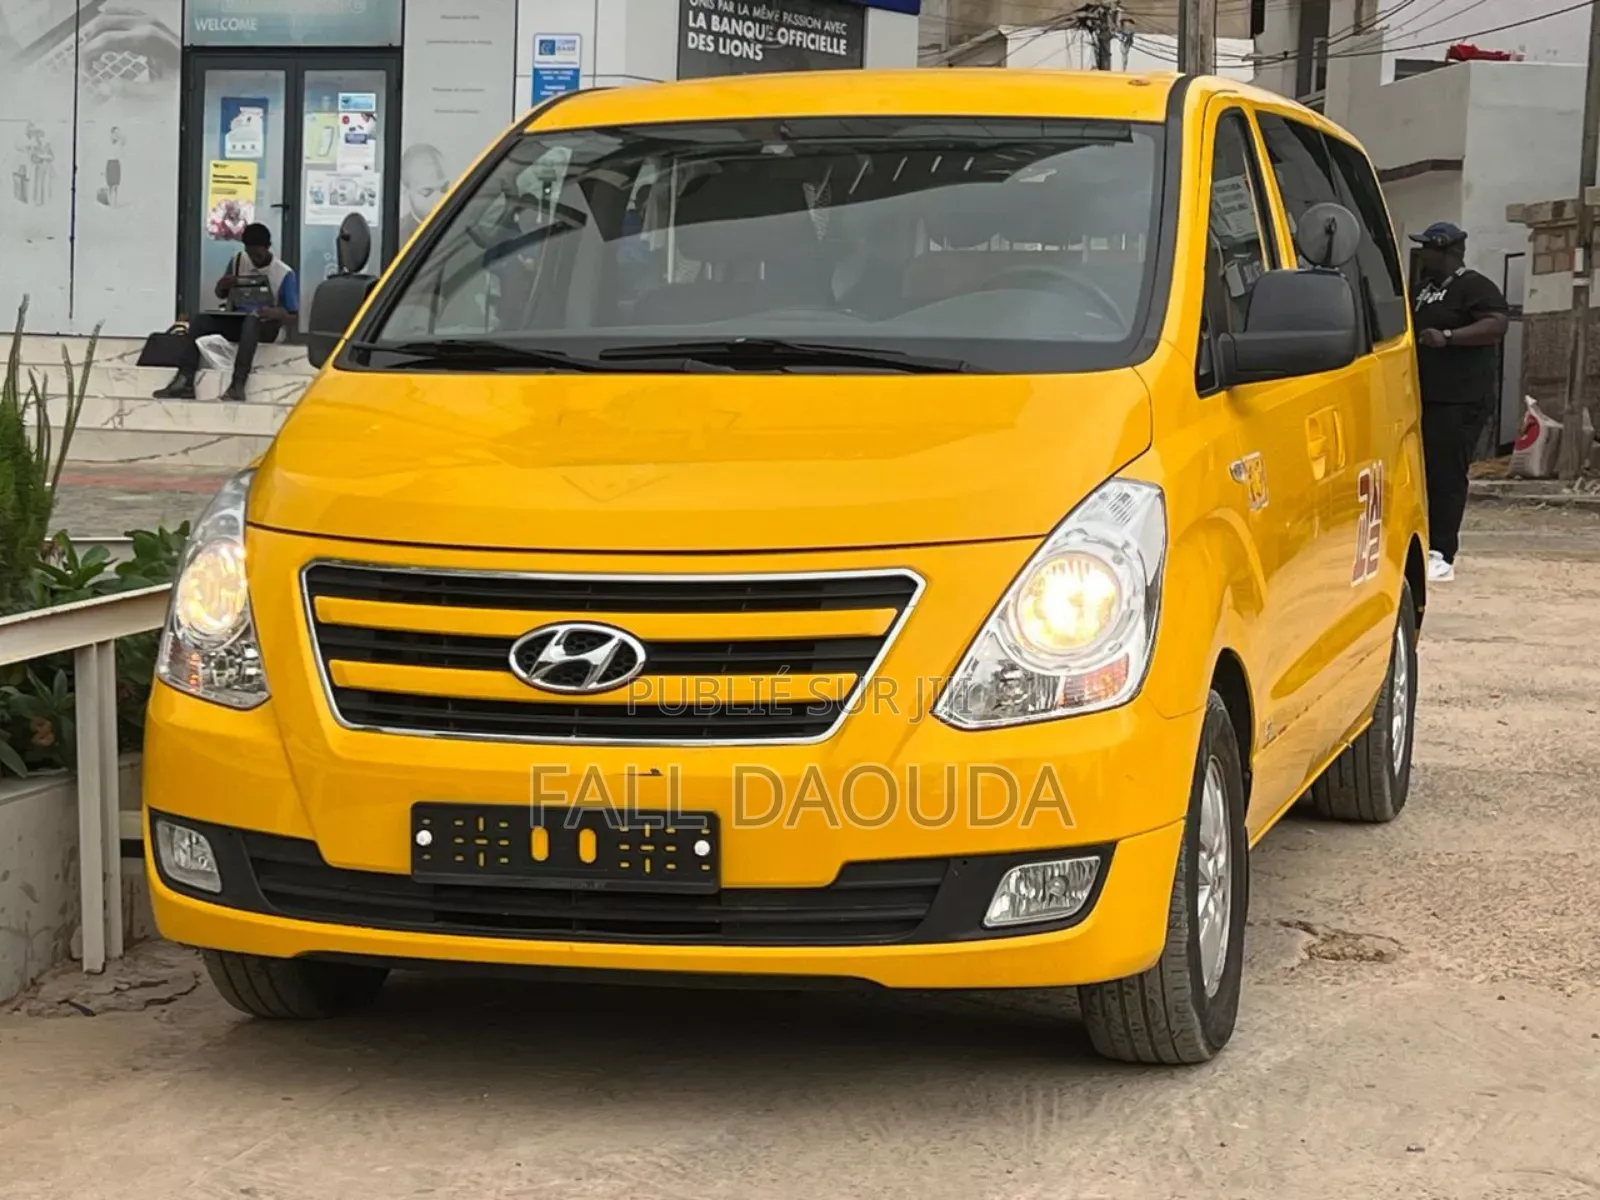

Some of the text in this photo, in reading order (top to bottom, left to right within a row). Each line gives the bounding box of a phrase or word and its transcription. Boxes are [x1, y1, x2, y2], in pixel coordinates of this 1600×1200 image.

[194, 17, 258, 31] WELCOME
[688, 10, 847, 56] LA BANQUE OFFICIELLE
[718, 0, 735, 13] PAR
[738, 2, 750, 16] LA
[782, 11, 822, 30] PASSION
[823, 20, 847, 36] AVEC
[687, 31, 763, 61] DES LIONS
